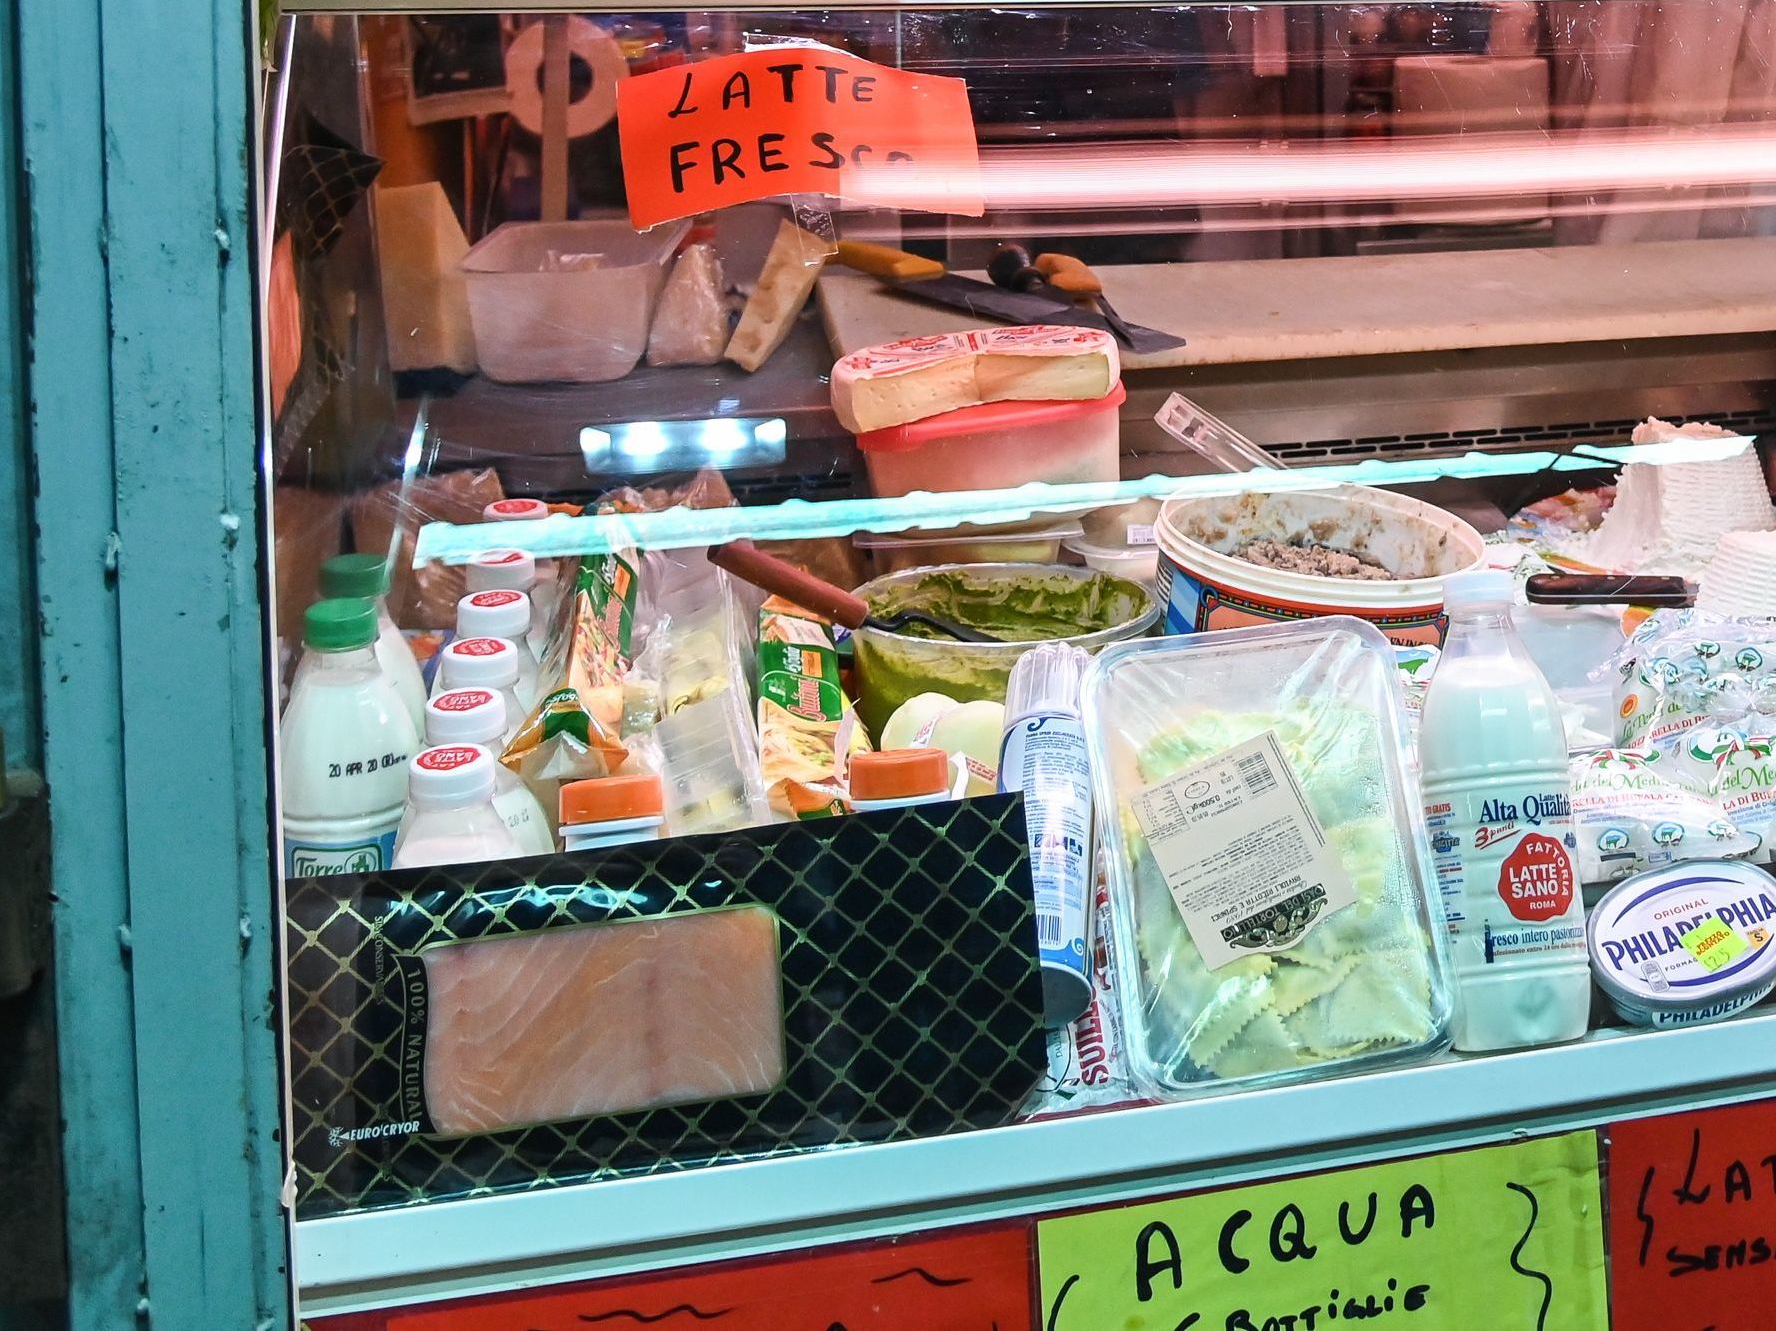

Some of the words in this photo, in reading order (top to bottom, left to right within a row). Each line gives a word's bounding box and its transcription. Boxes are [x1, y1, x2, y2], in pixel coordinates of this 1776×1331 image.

[667, 63, 879, 120] LATTE
[328, 763, 342, 778] 20
[345, 761, 363, 776] APR
[367, 759, 378, 773] 20
[1539, 793, 1555, 802] Latte
[1737, 795, 1749, 806] DI
[1478, 798, 1519, 824] Alta
[1474, 827, 1490, 848] 3
[1490, 822, 1515, 839] punti
[295, 857, 343, 879] Torre
[1508, 863, 1558, 883] LATTE
[1525, 841, 1570, 897] FATTORIA
[1274, 874, 1302, 889] RAVIOLI
[1511, 879, 1559, 899] SANO
[1245, 887, 1274, 905] RICOTTA
[1281, 895, 1299, 912] DEL
[1529, 900, 1556, 910] ROMA
[1653, 897, 1709, 921] ORIGINAL
[1521, 927, 1549, 944] intero
[407, 967, 426, 1025] 100%
[1135, 1184, 1436, 1302] ACQUA
